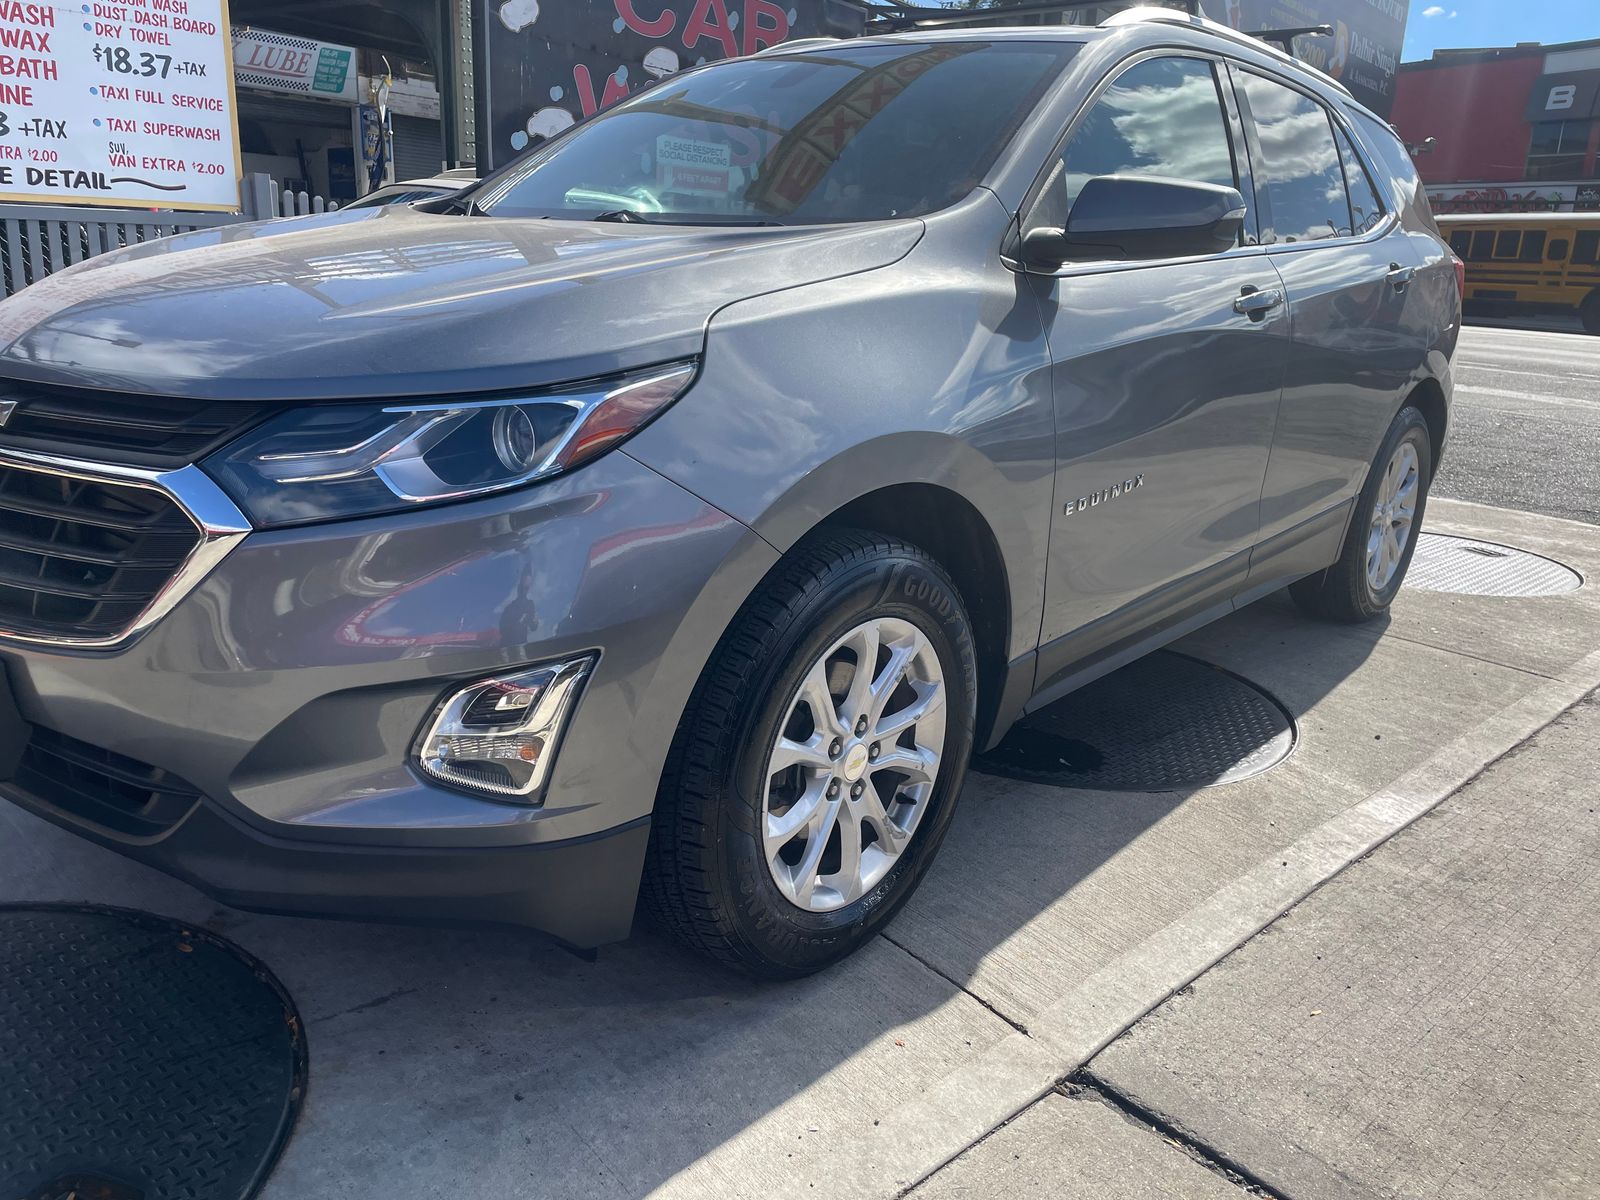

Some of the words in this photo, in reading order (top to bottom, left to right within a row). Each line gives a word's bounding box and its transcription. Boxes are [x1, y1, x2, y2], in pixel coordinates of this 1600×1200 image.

[93, 3, 128, 22] DUST
[134, 10, 169, 28] DASH
[173, 17, 216, 36] BOARD
[614, 0, 789, 58] CAR
[0, 28, 51, 53] WAX
[95, 22, 122, 39] DRY
[129, 27, 172, 46] TOWEL
[0, 55, 58, 80] BATH
[92, 43, 172, 79] $18.37
[174, 61, 207, 77] +TAX
[247, 44, 312, 74] LUBE
[99, 85, 129, 100] TAXI
[135, 89, 165, 104] FULL
[171, 94, 224, 112] SERVICE
[1545, 84, 1577, 111] B
[106, 118, 136, 133] TAXI
[143, 121, 220, 141] SUPERWASH
[27, 148, 58, 163] $2.00
[659, 149, 685, 161] SOCIAL
[686, 153, 728, 167] DISTANCING
[664, 140, 692, 153] PLEASE
[692, 144, 724, 157] RESPECT
[109, 154, 137, 168] VAN
[142, 157, 186, 172] EXTRA
[192, 162, 225, 175] $2.00
[25, 167, 112, 190] DETAIL
[1063, 473, 1145, 517] EQUINOX
